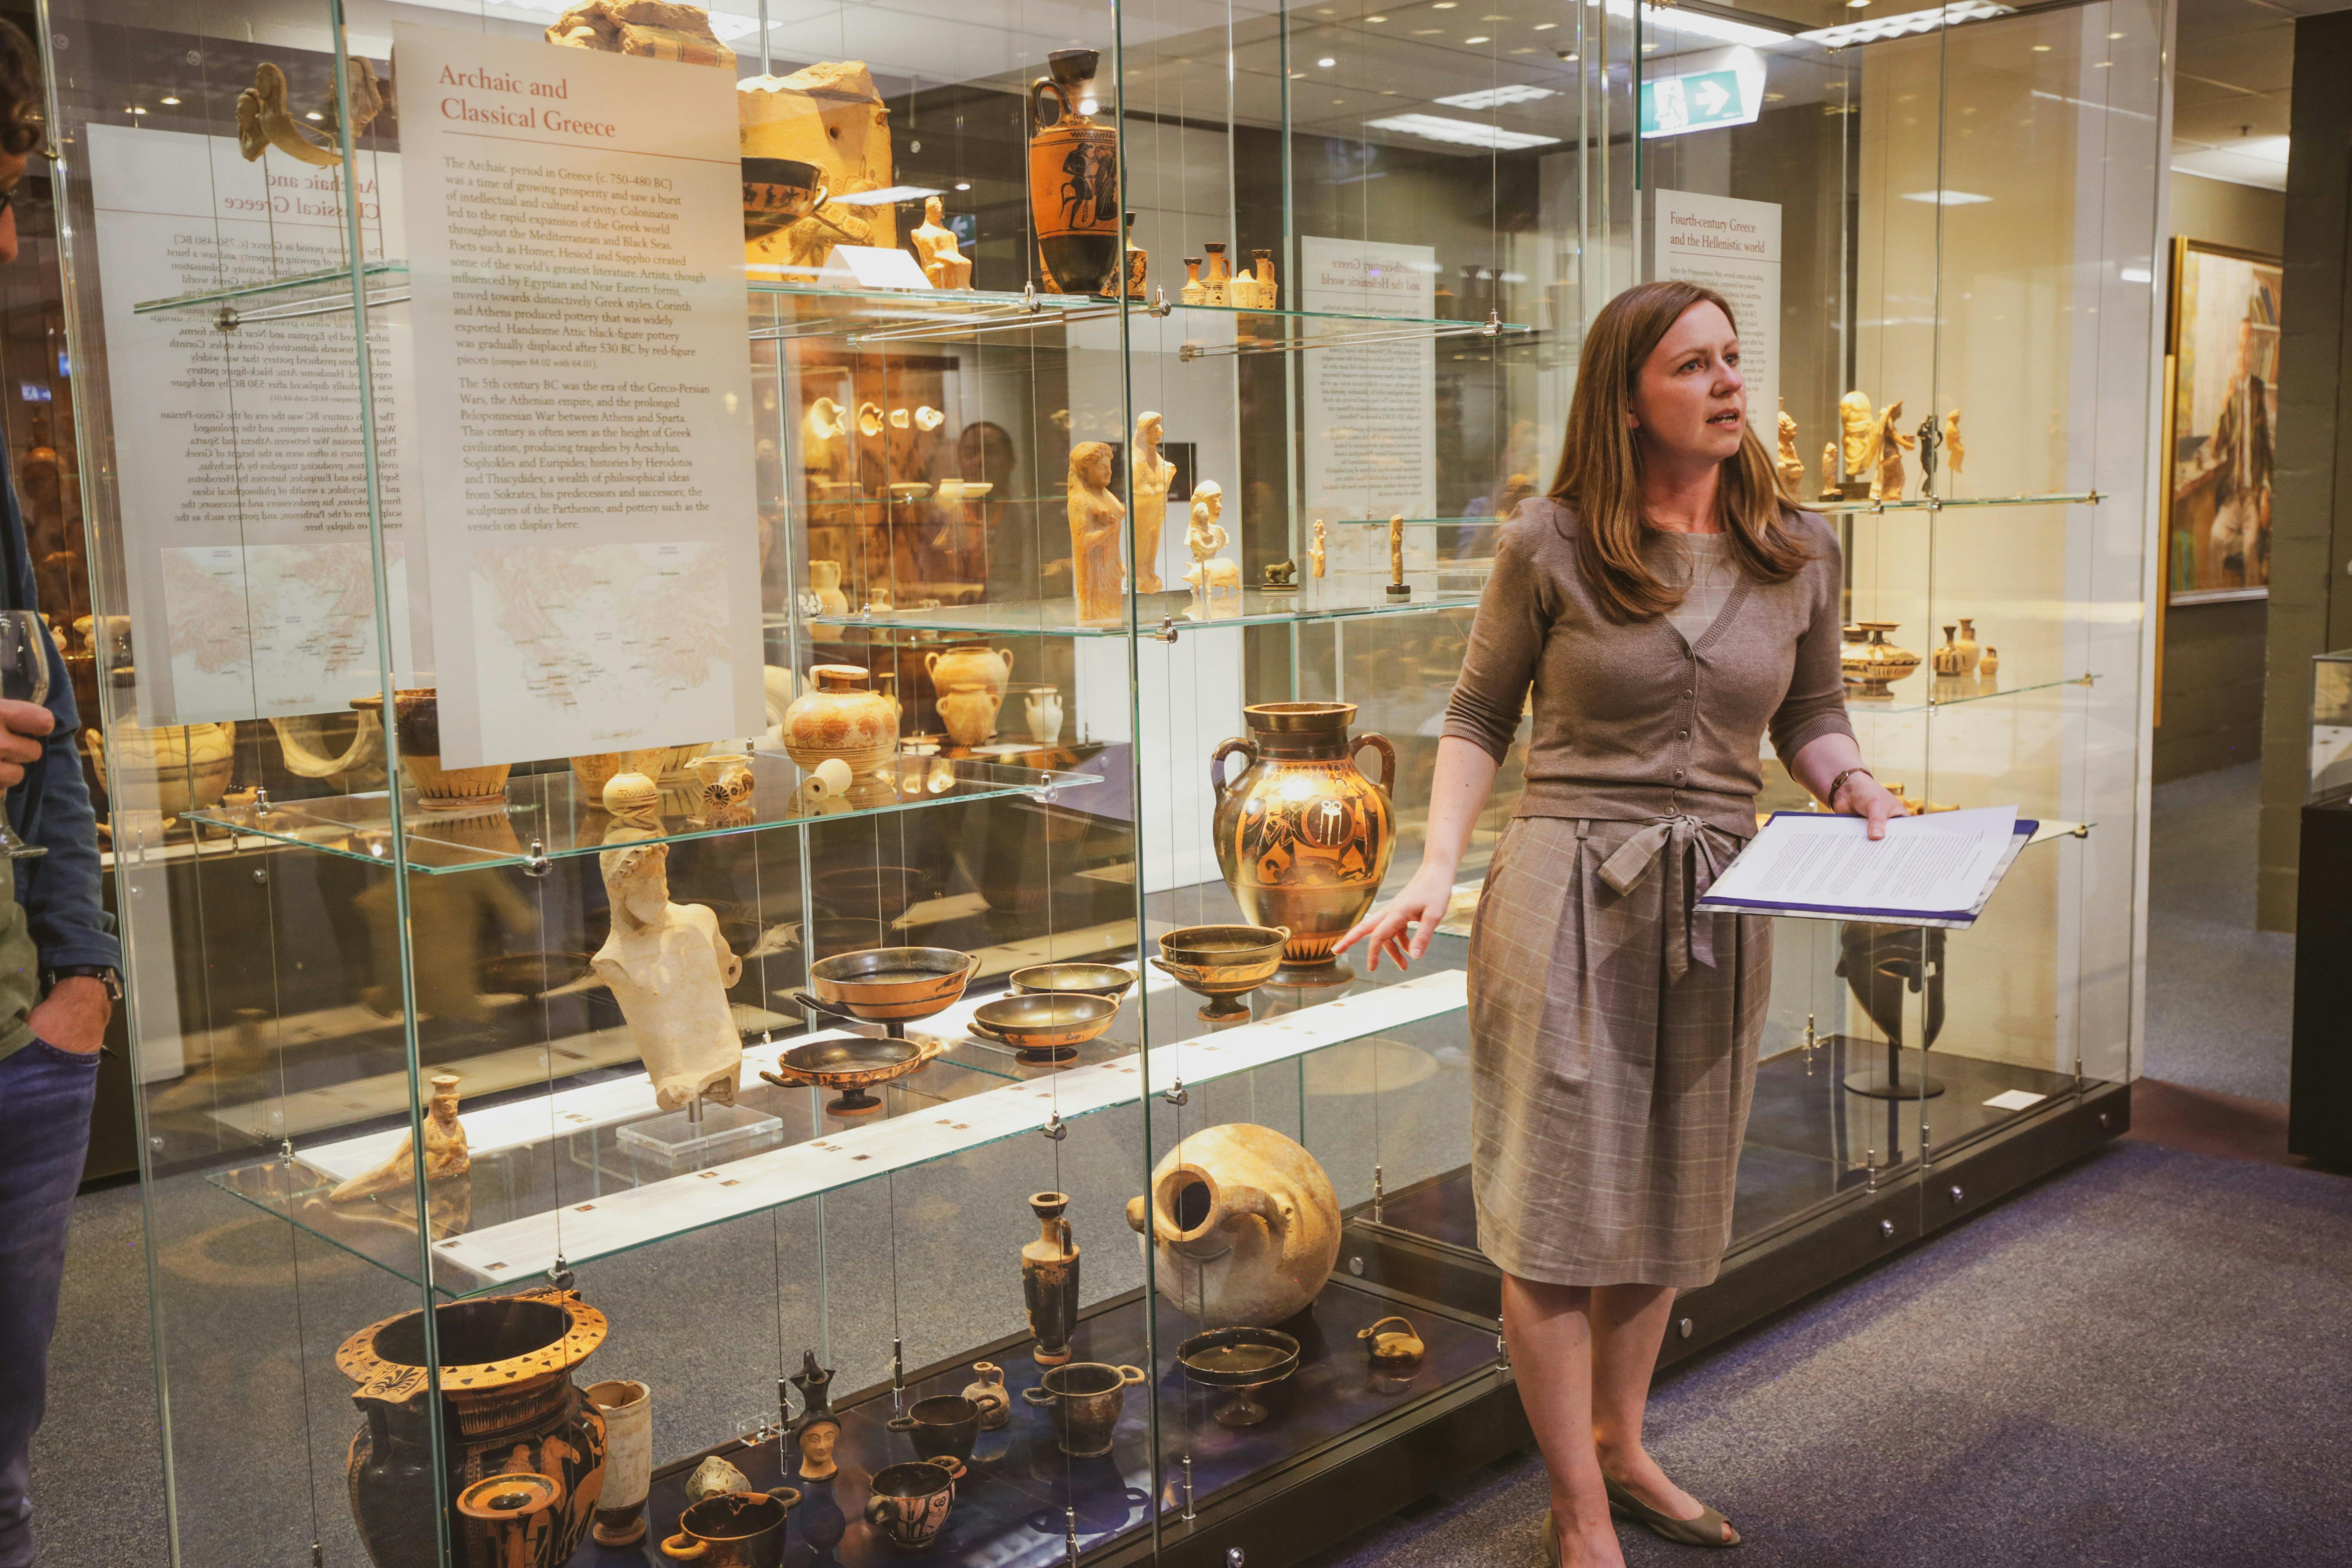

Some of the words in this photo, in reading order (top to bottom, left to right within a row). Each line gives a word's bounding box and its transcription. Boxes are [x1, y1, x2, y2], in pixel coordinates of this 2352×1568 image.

[438, 64, 522, 94] Archaic
[530, 78, 568, 100] and
[441, 98, 536, 129] Classical
[543, 110, 616, 138] Greece
[444, 157, 464, 168] The
[468, 159, 506, 173] Archaic
[511, 166, 543, 177] period
[558, 168, 593, 181] Greece
[654, 178, 672, 192] BC)
[477, 179, 499, 188] time
[502, 179, 513, 190] of
[516, 184, 557, 196] growing
[559, 188, 607, 200] prosperity
[611, 190, 628, 200] and
[658, 193, 681, 205] burst
[446, 191, 456, 200] of
[460, 193, 517, 206] intellectual
[520, 198, 539, 208] and
[541, 199, 579, 211] cultural
[620, 205, 679, 220] Colonisation
[447, 205, 463, 218] led
[466, 210, 477, 219] to
[480, 209, 497, 220] the
[500, 212, 526, 224] rapid
[529, 217, 578, 227] expansion
[581, 218, 591, 228] of
[593, 218, 609, 230] the
[612, 220, 640, 232] Greek
[643, 224, 670, 235] world
[1670, 211, 1727, 233] Fourth-century
[1730, 218, 1756, 233] Greece
[448, 223, 507, 237] throughout
[509, 227, 526, 239] the
[530, 230, 600, 245] Mediterranean
[603, 236, 620, 246] and
[623, 237, 648, 248] Black
[1670, 233, 1685, 245] and
[1687, 233, 1700, 247] the
[1702, 235, 1742, 251] Hellenistic
[1744, 240, 1764, 253] world
[450, 239, 477, 251] Poets
[480, 242, 503, 253] such
[559, 247, 593, 260] Hesiod
[596, 251, 612, 261] and
[616, 252, 651, 264] Sappho
[653, 255, 686, 266] created
[450, 259, 477, 267] some
[481, 258, 490, 268] of
[494, 259, 511, 269] the
[553, 266, 590, 275] greatest
[674, 271, 706, 285] though
[451, 273, 505, 285] influenced
[508, 276, 521, 288] by
[524, 277, 567, 290] Egyptian
[570, 280, 588, 290] and
[591, 281, 613, 291] Near
[616, 282, 650, 294] Eastern
[453, 290, 488, 300] moved
[490, 292, 530, 303] towards
[533, 293, 591, 308] distinctively
[595, 297, 624, 308] Greek
[656, 300, 691, 311] Corinth
[453, 305, 473, 315] and
[475, 306, 511, 317] Athens
[514, 309, 561, 320] produced
[564, 313, 599, 323] pottery
[601, 312, 621, 323] that
[643, 314, 673, 327] widely
[507, 324, 560, 335] Handsome
[563, 326, 586, 337] Attic
[589, 327, 644, 340] black-figure
[646, 332, 680, 343] pottery
[478, 339, 523, 352] gradually
[527, 340, 573, 353] displaced
[575, 342, 597, 352] after
[600, 343, 619, 353] 530
[621, 344, 636, 354] BC
[638, 344, 649, 358] by
[652, 345, 696, 358] red-figure
[523, 442, 573, 454] producing
[575, 442, 617, 454] tragedies
[619, 442, 631, 454] by
[463, 458, 516, 470] Sophokles
[518, 457, 536, 468] and
[590, 457, 629, 467] histories
[631, 457, 642, 469] by
[646, 457, 693, 467] Herodotos
[464, 474, 483, 484] and
[557, 472, 589, 483] wealth
[592, 473, 601, 482] of
[604, 472, 665, 485] philosophical
[668, 472, 690, 482] ideas
[466, 489, 490, 499] from
[540, 488, 554, 498] his
[557, 488, 616, 501] predecessors
[619, 488, 635, 497] and
[688, 487, 702, 496] the
